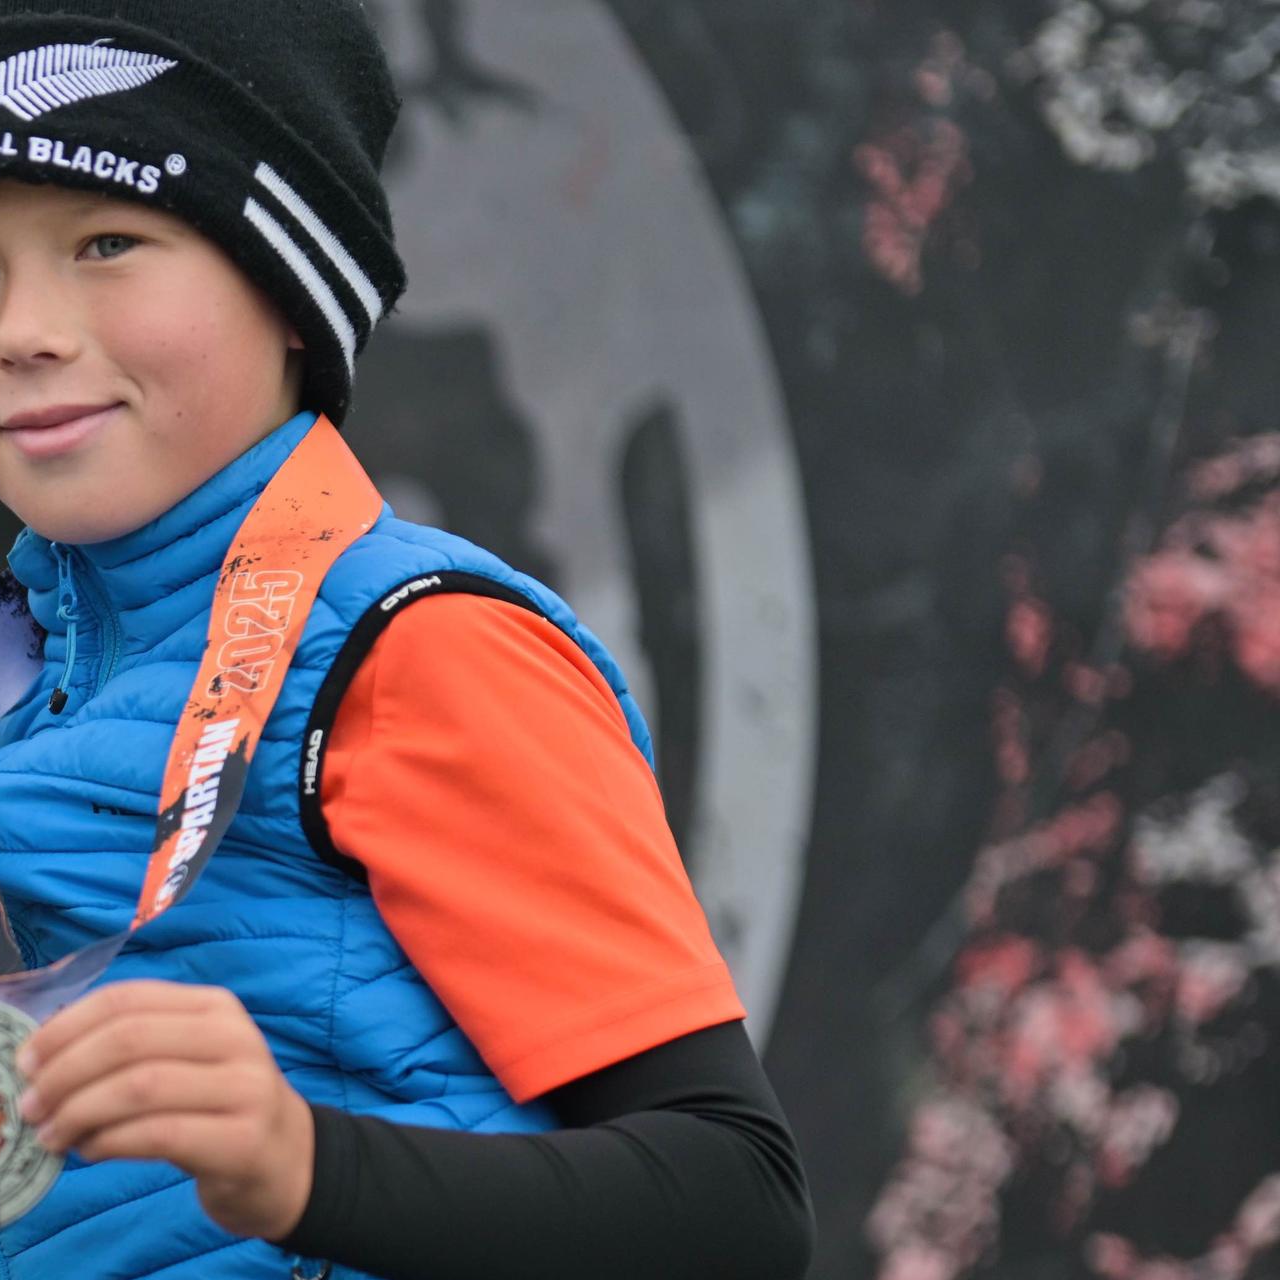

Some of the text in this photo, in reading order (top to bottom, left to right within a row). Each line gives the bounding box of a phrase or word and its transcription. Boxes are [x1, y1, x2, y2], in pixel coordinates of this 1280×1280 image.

[380, 575, 441, 611] HEAD
[168, 569, 304, 870] SPARTAN 2025
[304, 729, 323, 794] HEAD
